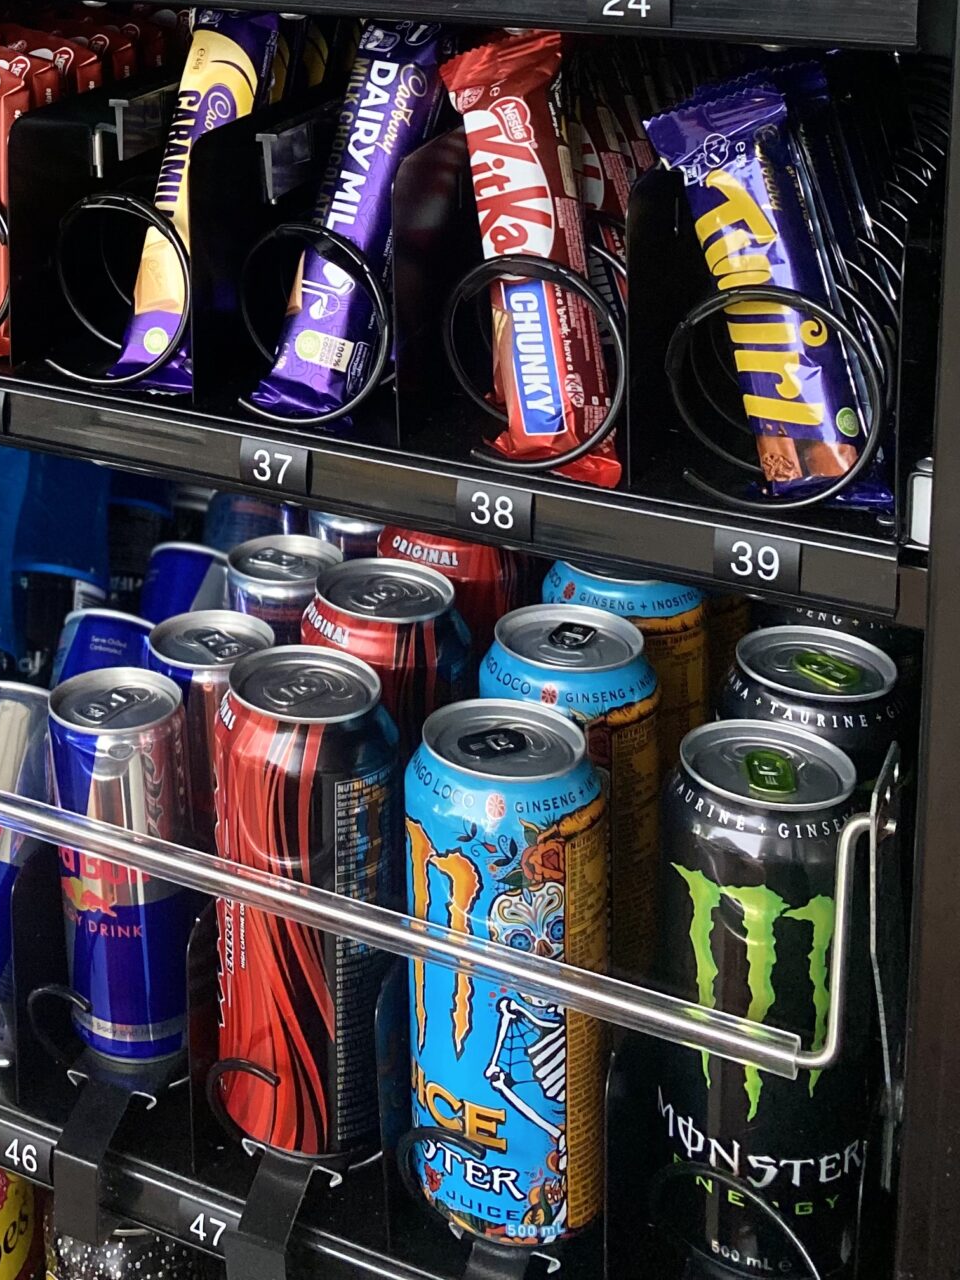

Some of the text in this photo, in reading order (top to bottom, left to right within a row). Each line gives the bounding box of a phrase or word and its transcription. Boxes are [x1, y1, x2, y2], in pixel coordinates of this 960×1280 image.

[344, 58, 370, 109] MILK
[375, 63, 428, 155] Cadbury
[326, 59, 399, 232] DAIRY MIL
[466, 125, 553, 257] KitKa
[694, 167, 828, 426] Twirl
[333, 341, 346, 368] 100%
[508, 290, 557, 416] CHUNKY
[252, 449, 293, 485] 37
[470, 491, 514, 530] 38
[392, 535, 459, 566] ORIGINAL
[729, 541, 781, 582] 39
[579, 590, 698, 612] GINSENG INOSITOL
[496, 671, 626, 704] LOCO GINSENG
[770, 701, 869, 729] TAURINE
[433, 782, 577, 815] LOCO GINSENG
[673, 773, 746, 832] TAURINE
[89, 920, 144, 939] DRINK
[657, 1084, 868, 1189] MONSTER
[5, 1138, 38, 1173] 46
[445, 1188, 524, 1222] JUICE
[189, 1212, 228, 1248] 47
[506, 1222, 566, 1238] 500 mL
[711, 1238, 773, 1271] 500 mL
